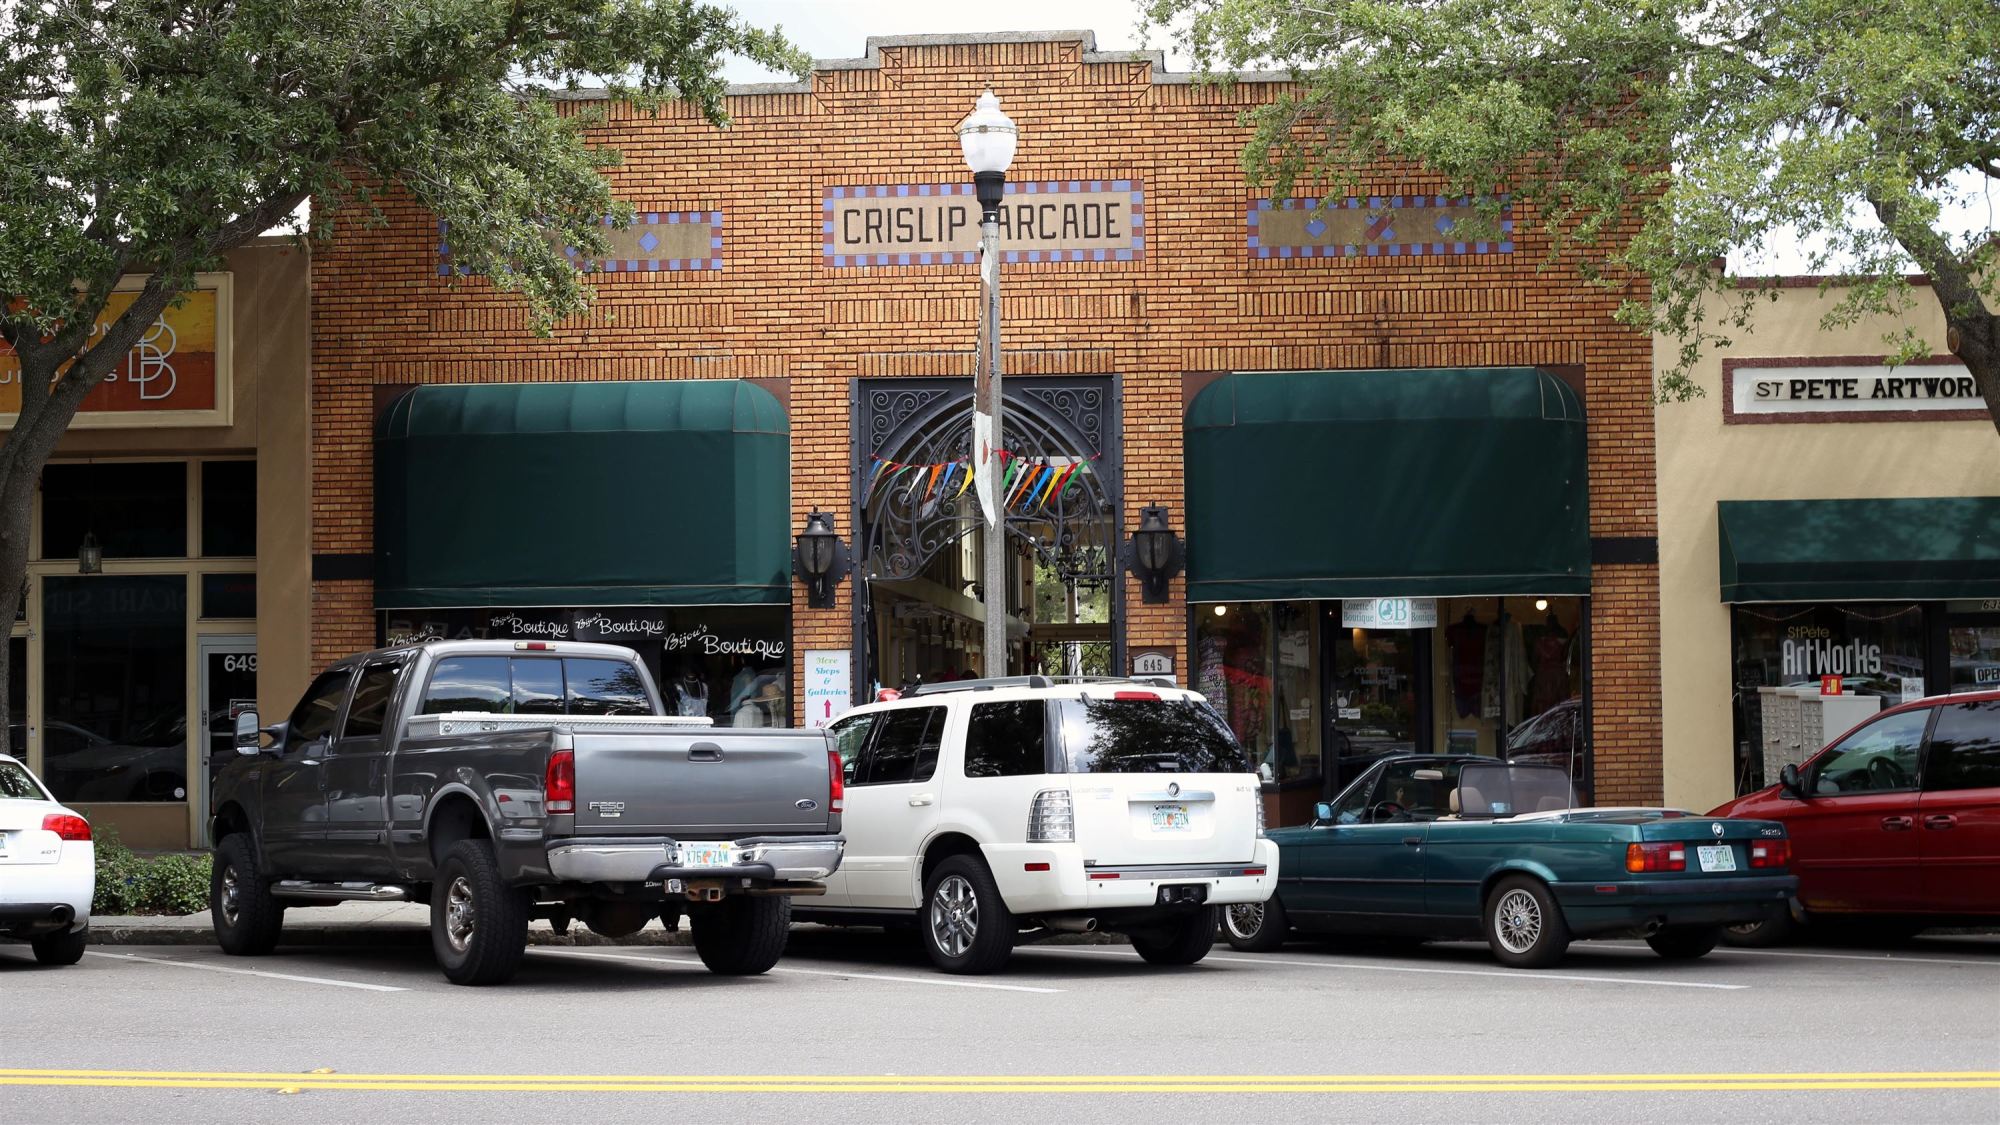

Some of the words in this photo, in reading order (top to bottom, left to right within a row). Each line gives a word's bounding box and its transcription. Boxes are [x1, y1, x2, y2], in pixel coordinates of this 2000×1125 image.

[843, 206, 966, 244] CRISLIP
[998, 202, 1121, 241] ARCADE
[1756, 382, 1783, 397] ST
[1789, 379, 1858, 399] PETE
[490, 612, 515, 627] Bijou's
[508, 617, 569, 639] Boutique
[575, 613, 601, 630] Bijou's
[595, 618, 665, 637] Boutique
[1343, 612, 1374, 625] Boutique
[664, 624, 708, 651] Bijou's
[698, 634, 786, 661] Boutique
[223, 655, 256, 672] 649
[1143, 659, 1162, 671] 645
[1783, 638, 1881, 675] ArtWorks
[816, 667, 840, 675] Shops
[823, 677, 832, 685] &
[808, 688, 847, 697] Galleries
[590, 801, 625, 810] F250
